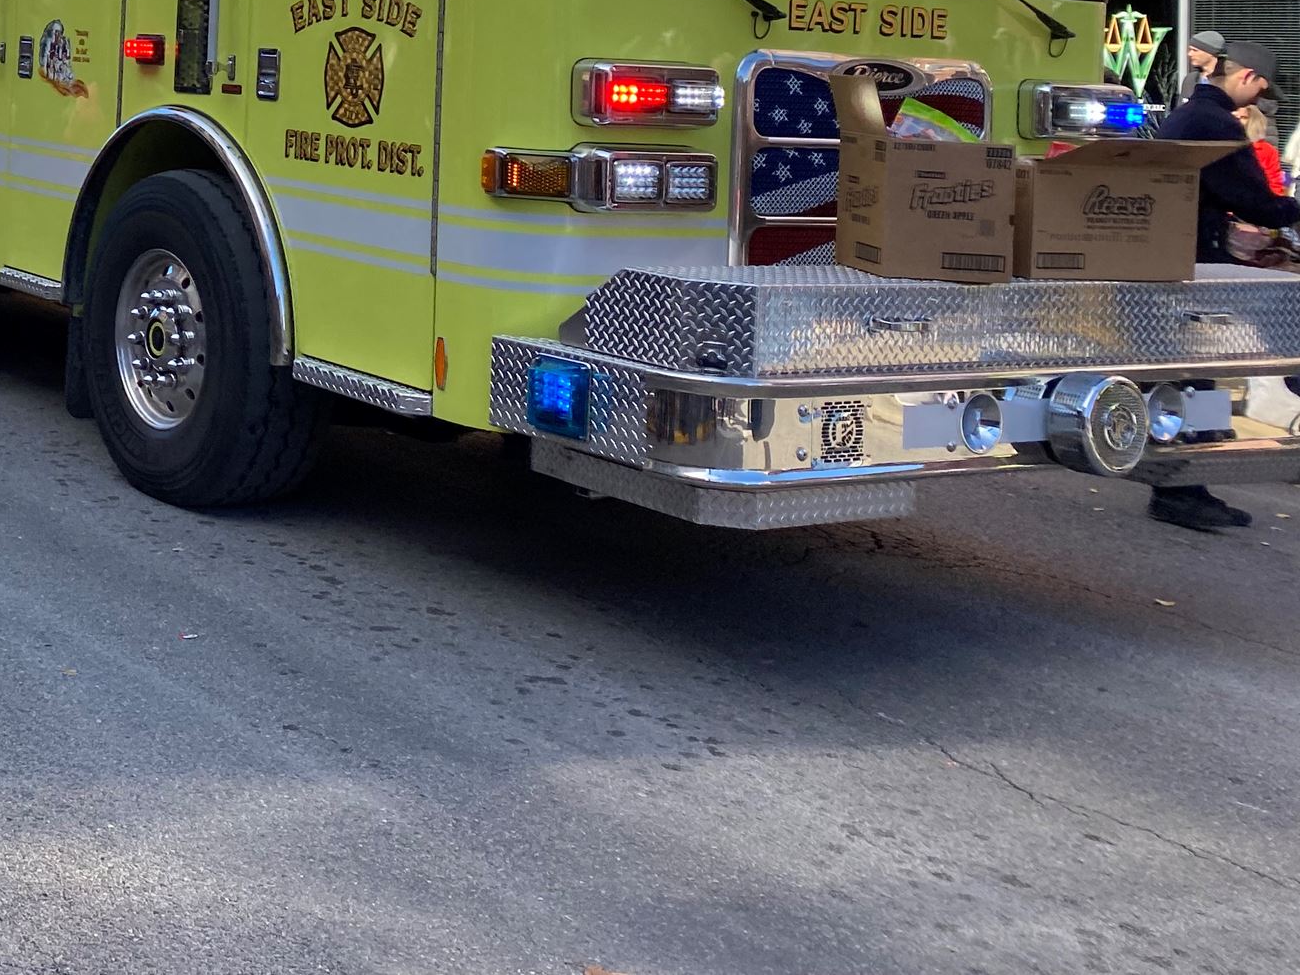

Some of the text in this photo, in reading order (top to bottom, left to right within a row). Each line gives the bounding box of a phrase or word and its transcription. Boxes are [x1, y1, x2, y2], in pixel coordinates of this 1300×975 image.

[880, 4, 949, 40] SIDE
[285, 129, 424, 177] FIRE PROT. DIST.
